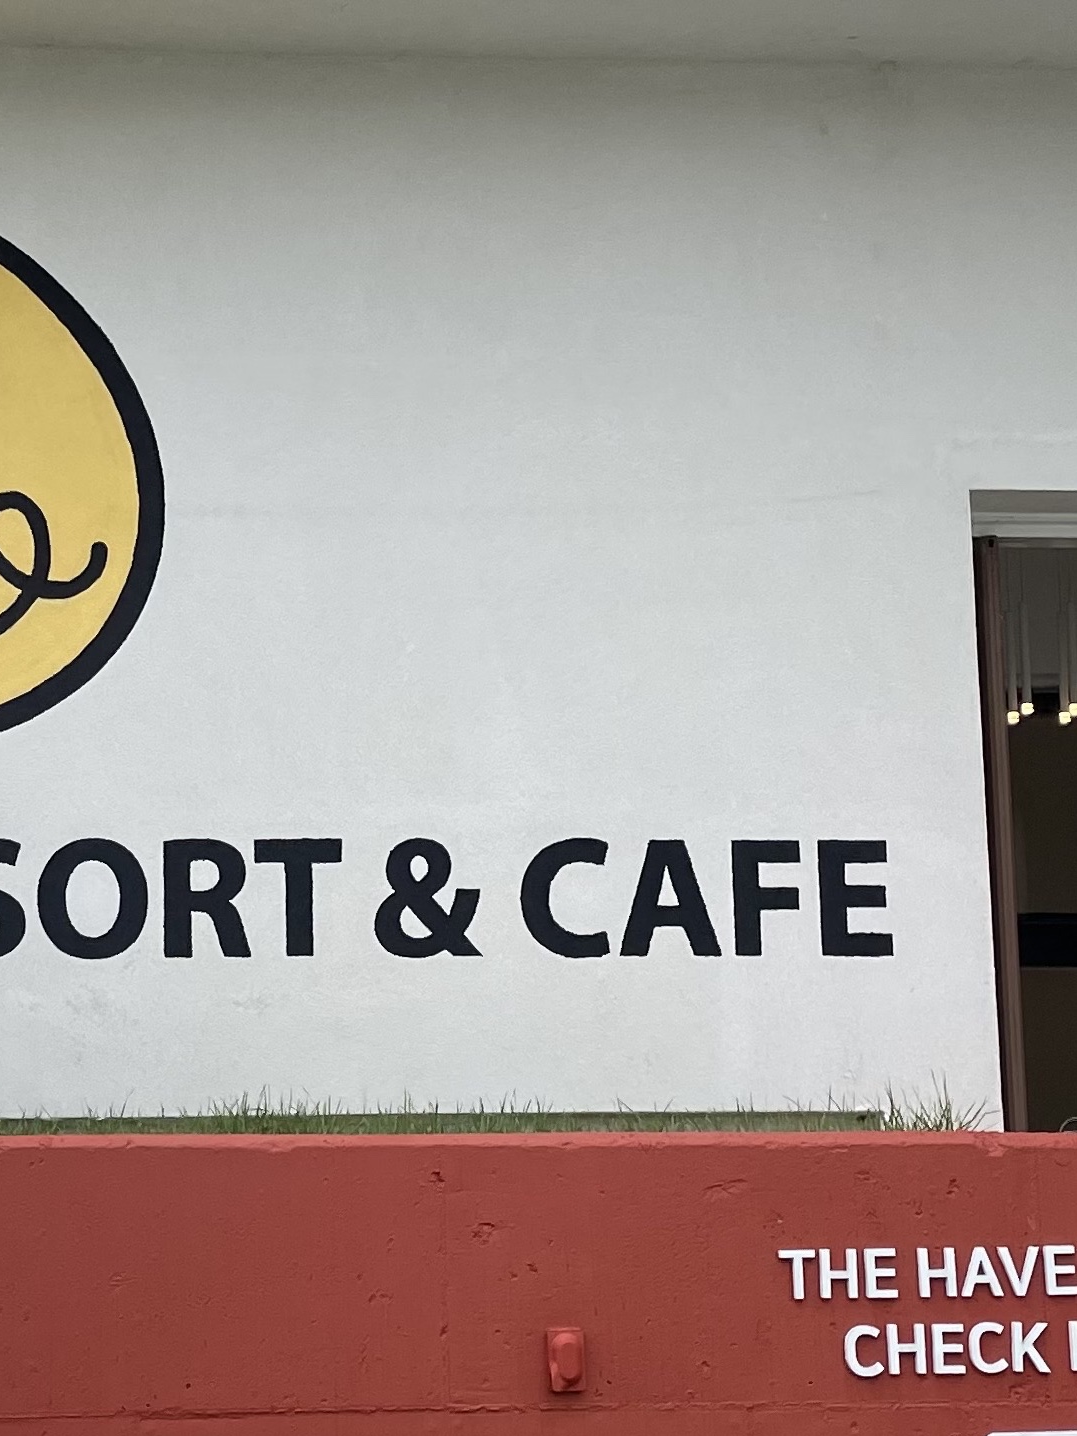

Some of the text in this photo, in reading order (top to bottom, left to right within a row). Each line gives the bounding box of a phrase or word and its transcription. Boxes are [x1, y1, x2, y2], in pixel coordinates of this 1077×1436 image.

[374, 838, 483, 958] &
[520, 838, 894, 958] CAFE
[778, 1248, 899, 1300] THE
[844, 1321, 1052, 1377] CHECK
